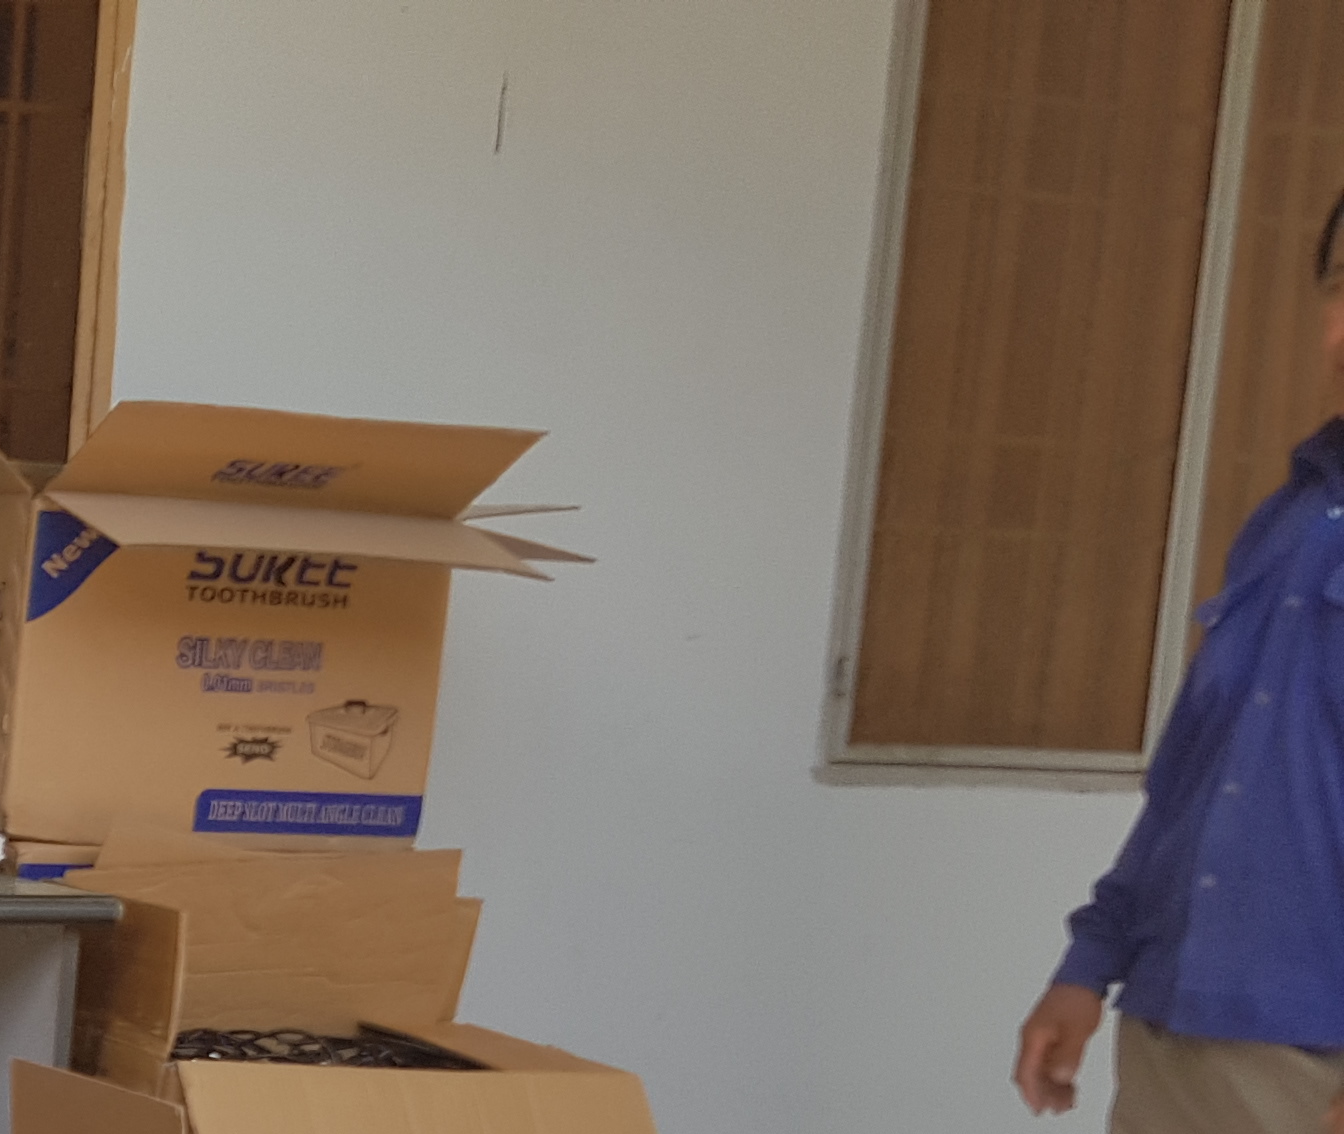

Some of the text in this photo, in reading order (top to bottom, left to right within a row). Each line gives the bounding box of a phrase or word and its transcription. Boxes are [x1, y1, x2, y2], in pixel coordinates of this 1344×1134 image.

[41, 526, 100, 579] New
[186, 585, 350, 609] TOOTHBRUSH
[177, 636, 248, 669] SILKY
